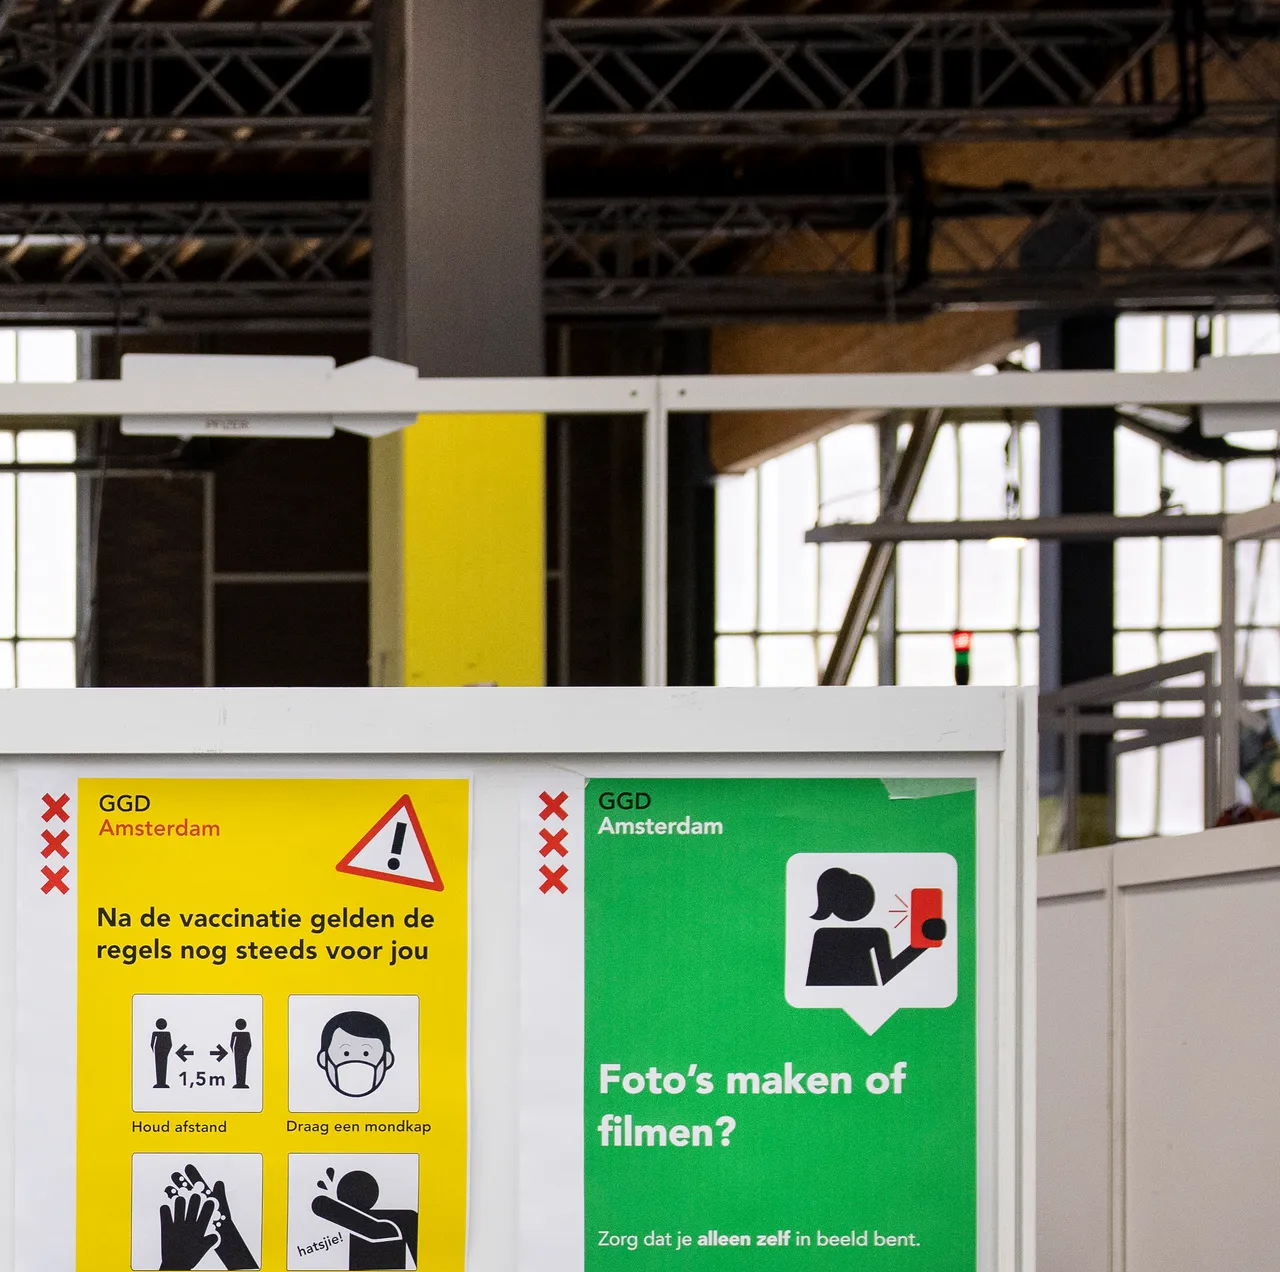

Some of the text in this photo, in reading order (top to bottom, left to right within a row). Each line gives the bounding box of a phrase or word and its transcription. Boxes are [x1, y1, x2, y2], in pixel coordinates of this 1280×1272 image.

[100, 795, 150, 812] GGD
[599, 792, 651, 810] GGD
[99, 818, 219, 836] Amsterdam
[598, 816, 723, 834] Amsterdam
[98, 907, 434, 933] Na de vaccinatie gelden de
[98, 938, 427, 965] regels nog steeds voor jou
[727, 1062, 852, 1094] maken
[866, 1062, 907, 1094] of
[133, 1121, 226, 1132] Houd afstand
[287, 1121, 328, 1135] Draag
[366, 1120, 431, 1135] mondkap
[598, 1114, 736, 1146] filmen?
[297, 1232, 343, 1256] hatsjie!
[598, 1230, 920, 1250] Zorg dat je alleen zelf in beeld bent.
